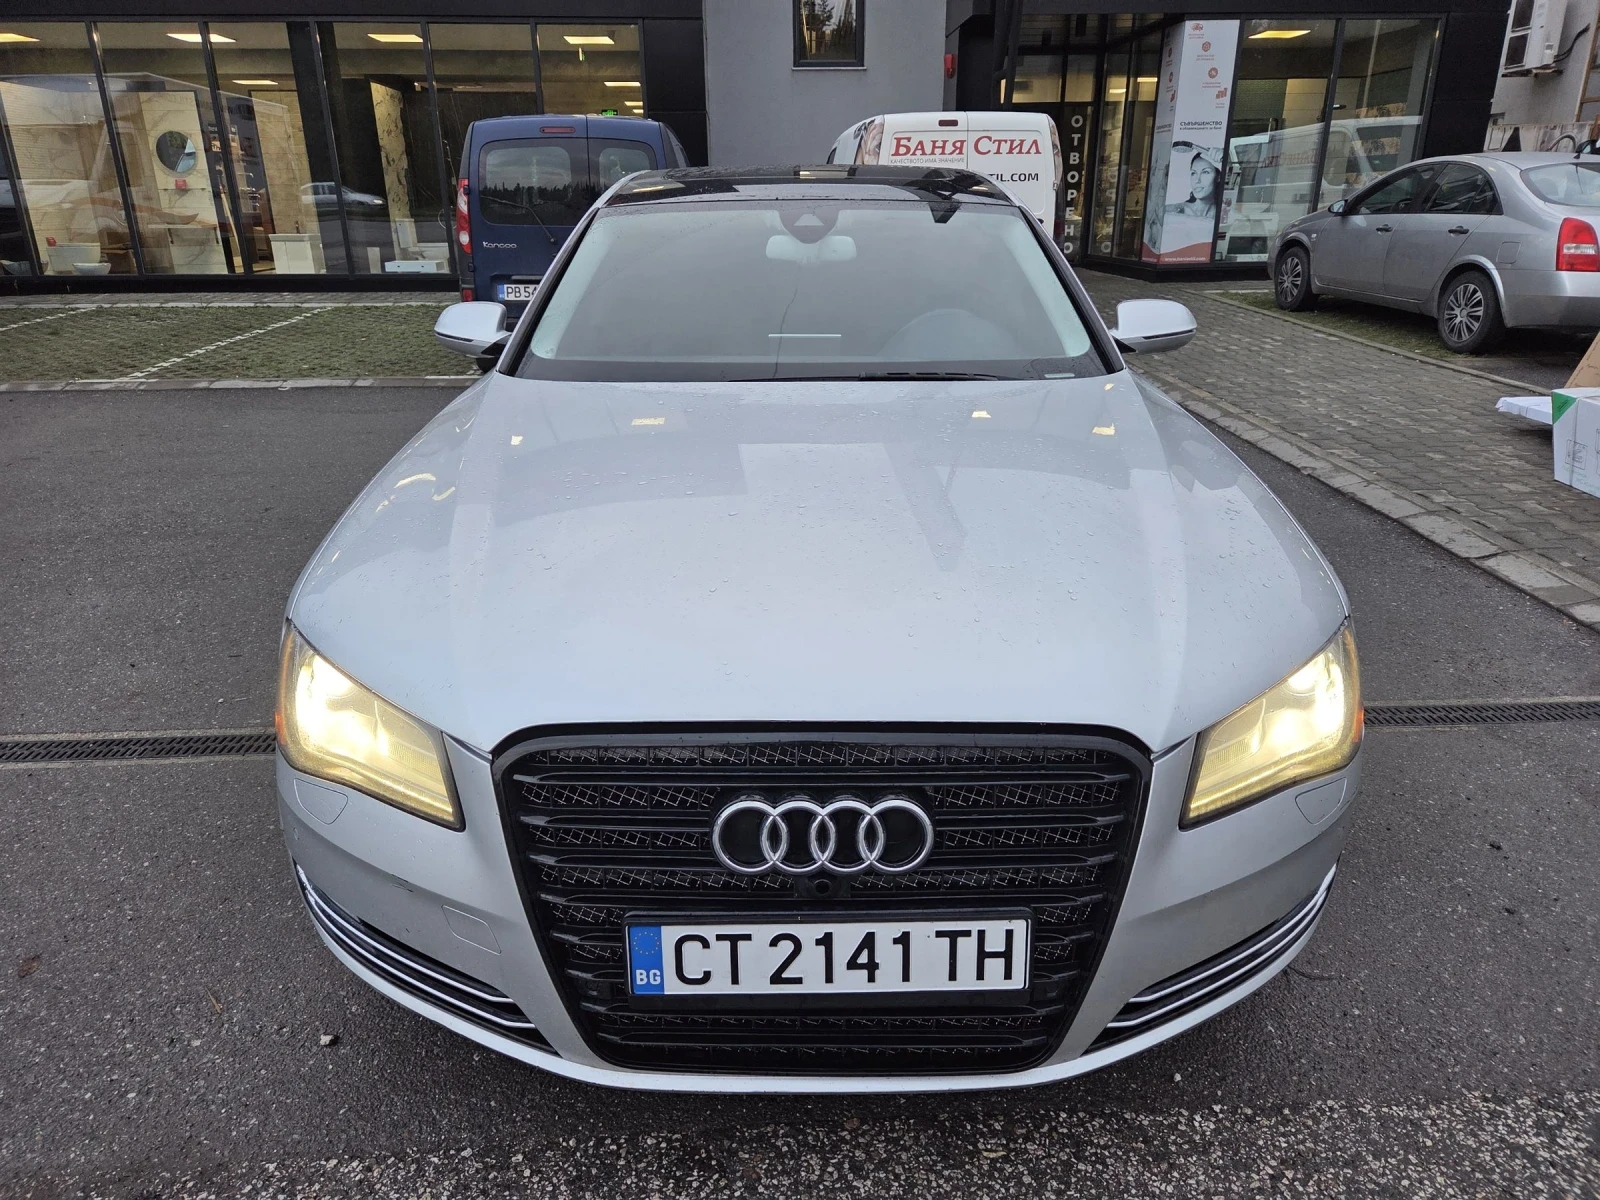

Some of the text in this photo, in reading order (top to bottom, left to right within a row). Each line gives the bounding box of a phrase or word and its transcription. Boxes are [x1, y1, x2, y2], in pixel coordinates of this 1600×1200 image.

[891, 135, 1042, 157] БАНЯ СТИЛ
[1063, 114, 1083, 254] ОТВОРЕНО
[506, 286, 522, 299] PB
[674, 928, 1015, 987] CT 2141 TH
[635, 969, 661, 985] BG
